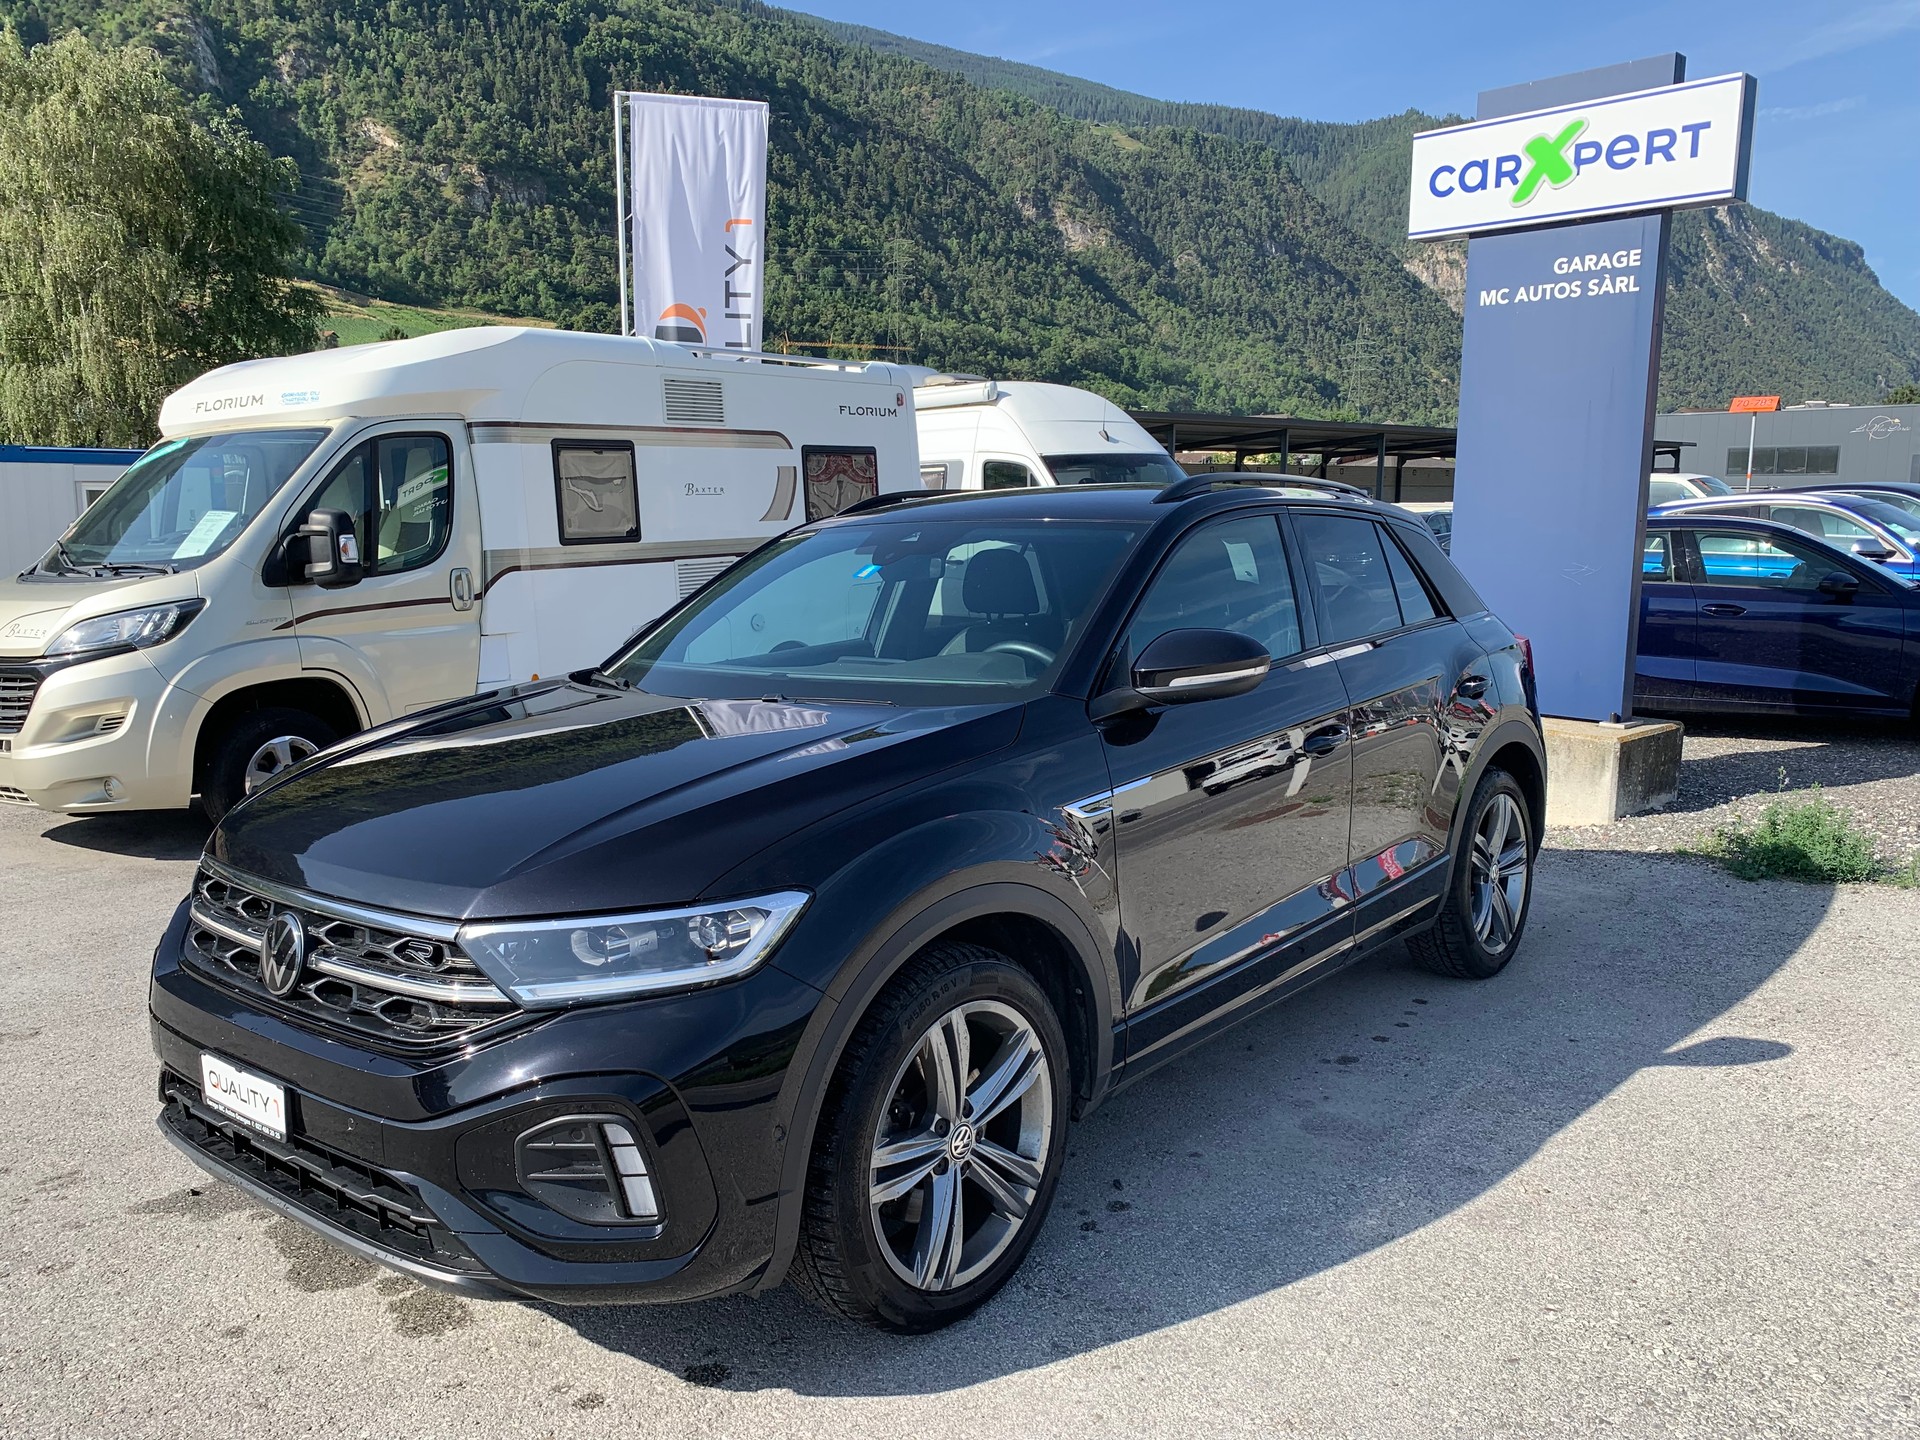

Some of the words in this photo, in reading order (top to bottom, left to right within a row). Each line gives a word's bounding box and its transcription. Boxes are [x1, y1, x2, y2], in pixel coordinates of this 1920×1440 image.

[1553, 248, 1642, 275] GARAGE
[1479, 287, 1509, 307] MC
[1513, 280, 1582, 304] AUTOS
[1588, 274, 1640, 296] SÀRL
[195, 394, 264, 414] FLORIUM
[838, 405, 898, 418] FLORIUM
[208, 1069, 270, 1112] QUALITY
